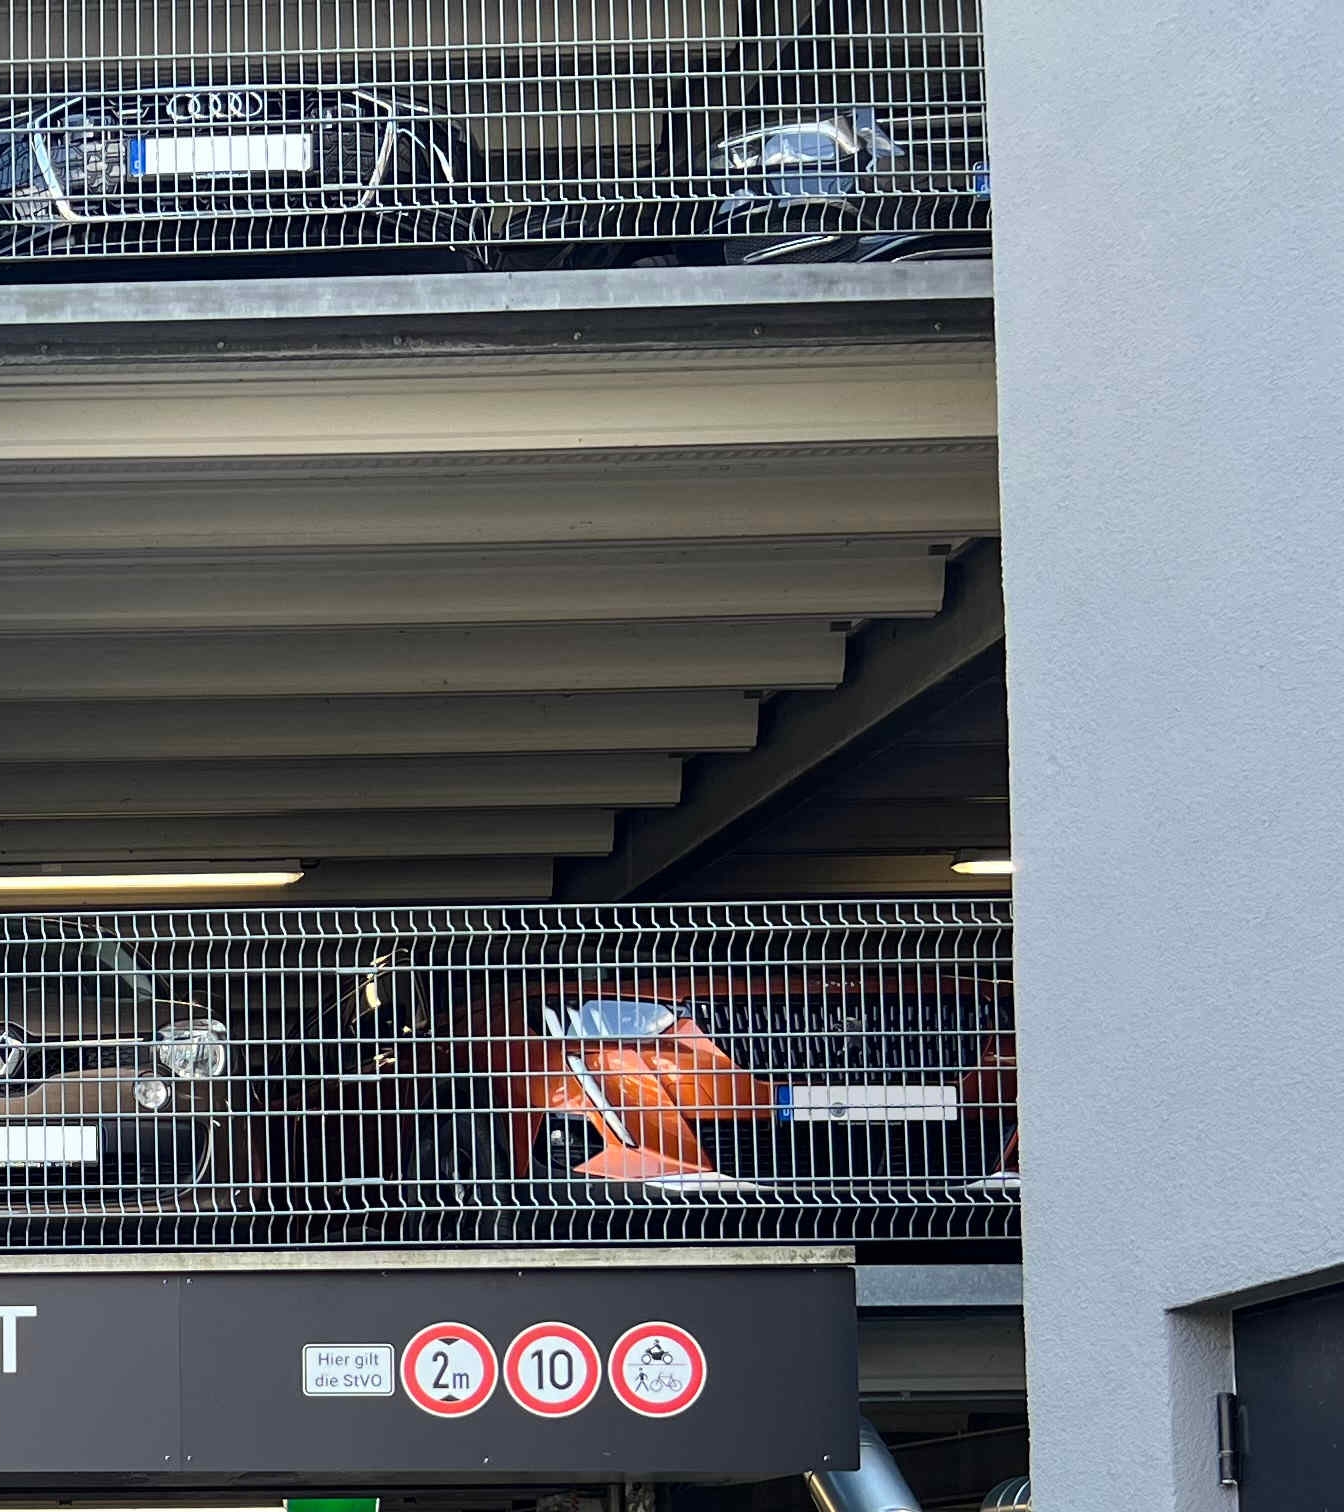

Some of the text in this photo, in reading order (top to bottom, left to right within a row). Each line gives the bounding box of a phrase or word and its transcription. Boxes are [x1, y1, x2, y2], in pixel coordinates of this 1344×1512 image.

[317, 1352, 380, 1370] Hier gilt
[530, 1349, 574, 1391] 10
[314, 1374, 383, 1389] die StVO
